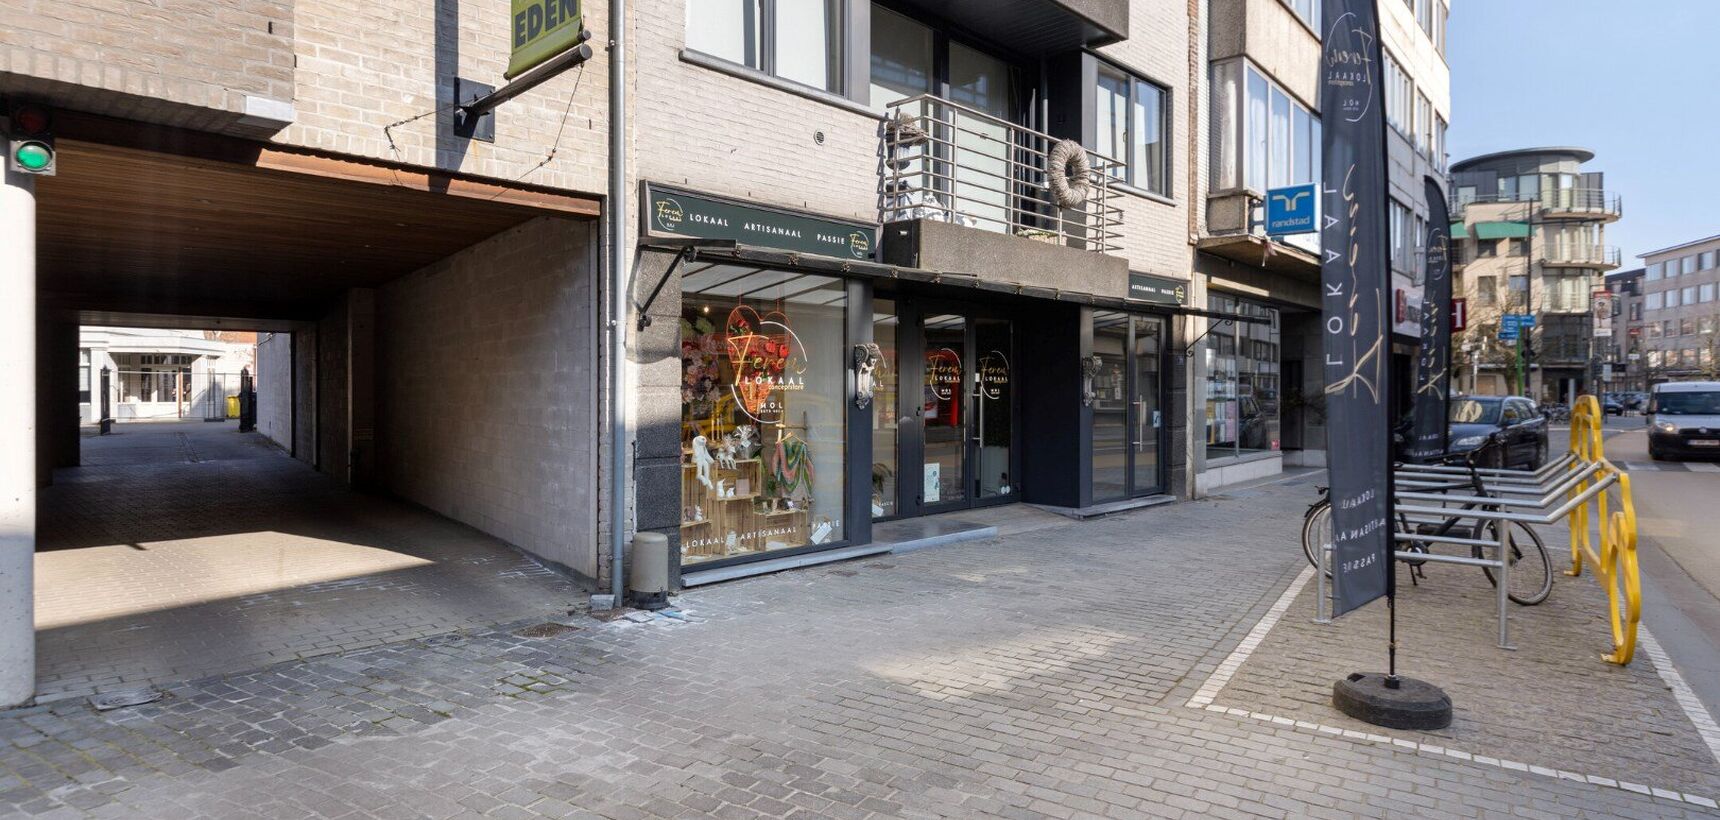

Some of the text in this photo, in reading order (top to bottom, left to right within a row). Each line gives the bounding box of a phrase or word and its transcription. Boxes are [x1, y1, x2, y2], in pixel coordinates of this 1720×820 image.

[514, 0, 578, 48] EDEN
[689, 213, 729, 227] LOKAAL
[744, 222, 802, 238] ARTISANAAL
[816, 233, 846, 245] PASSIE
[1272, 216, 1311, 228] randstad
[744, 376, 805, 386] LOKAAL
[686, 536, 726, 549] LOKAAL
[739, 526, 797, 541] ARTISANAAL
